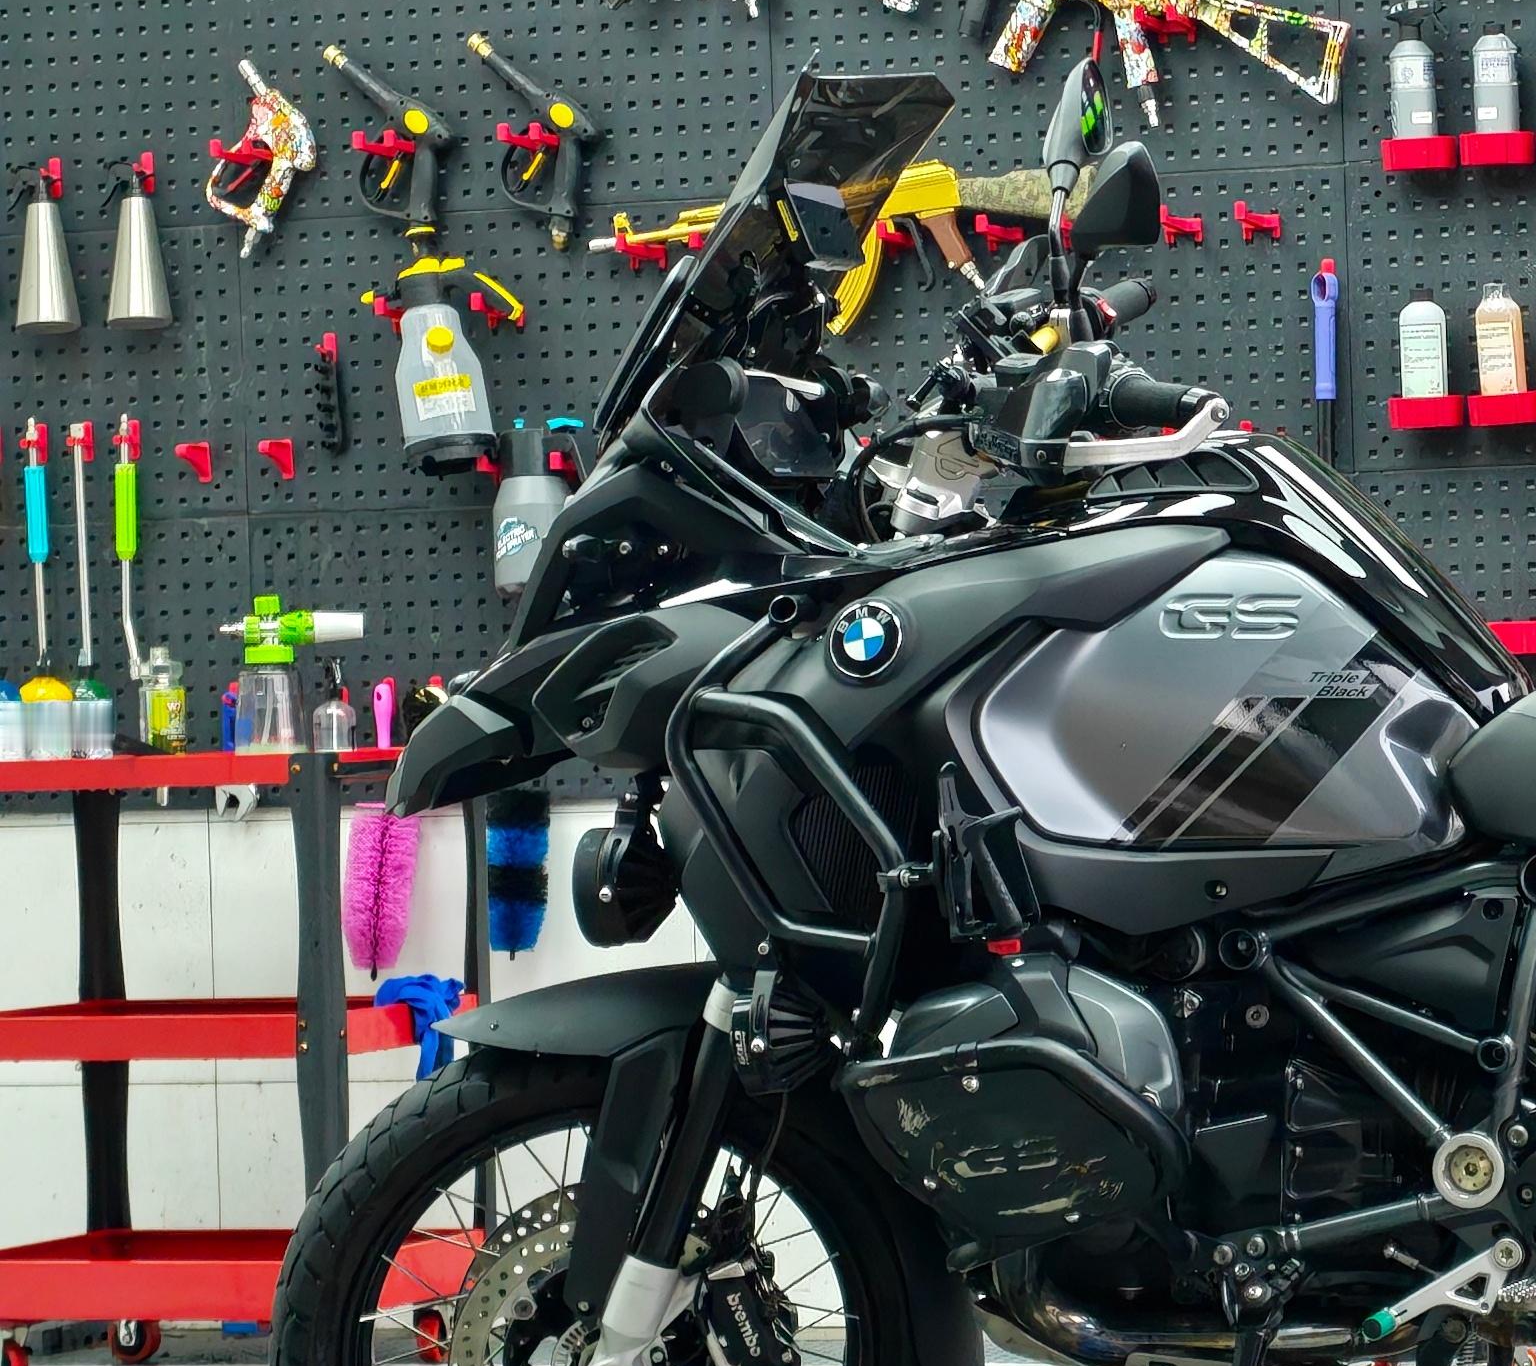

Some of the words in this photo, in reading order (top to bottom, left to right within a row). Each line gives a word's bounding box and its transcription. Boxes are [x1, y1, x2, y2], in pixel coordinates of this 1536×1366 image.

[836, 606, 891, 634] BMW
[1159, 592, 1303, 640] GS
[1307, 671, 1360, 686] Triple
[1316, 686, 1370, 698] Black
[726, 1291, 761, 1357] brembo
